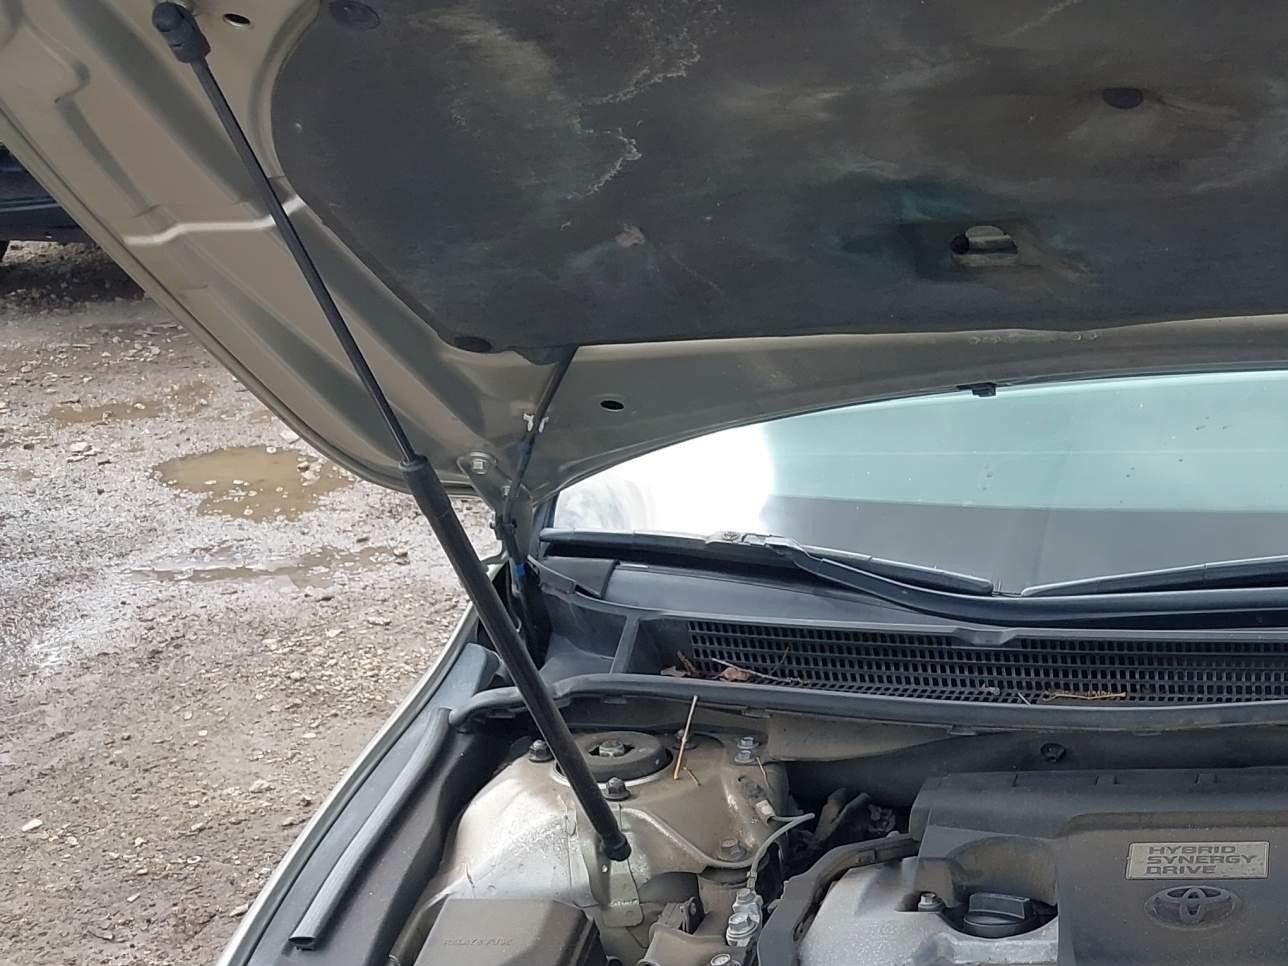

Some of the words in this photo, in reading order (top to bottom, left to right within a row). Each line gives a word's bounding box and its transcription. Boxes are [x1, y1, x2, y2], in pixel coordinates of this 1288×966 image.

[1148, 845, 1236, 855] HYBRID
[1146, 855, 1257, 865] SYNERGY
[1145, 865, 1217, 875] DRIVE
